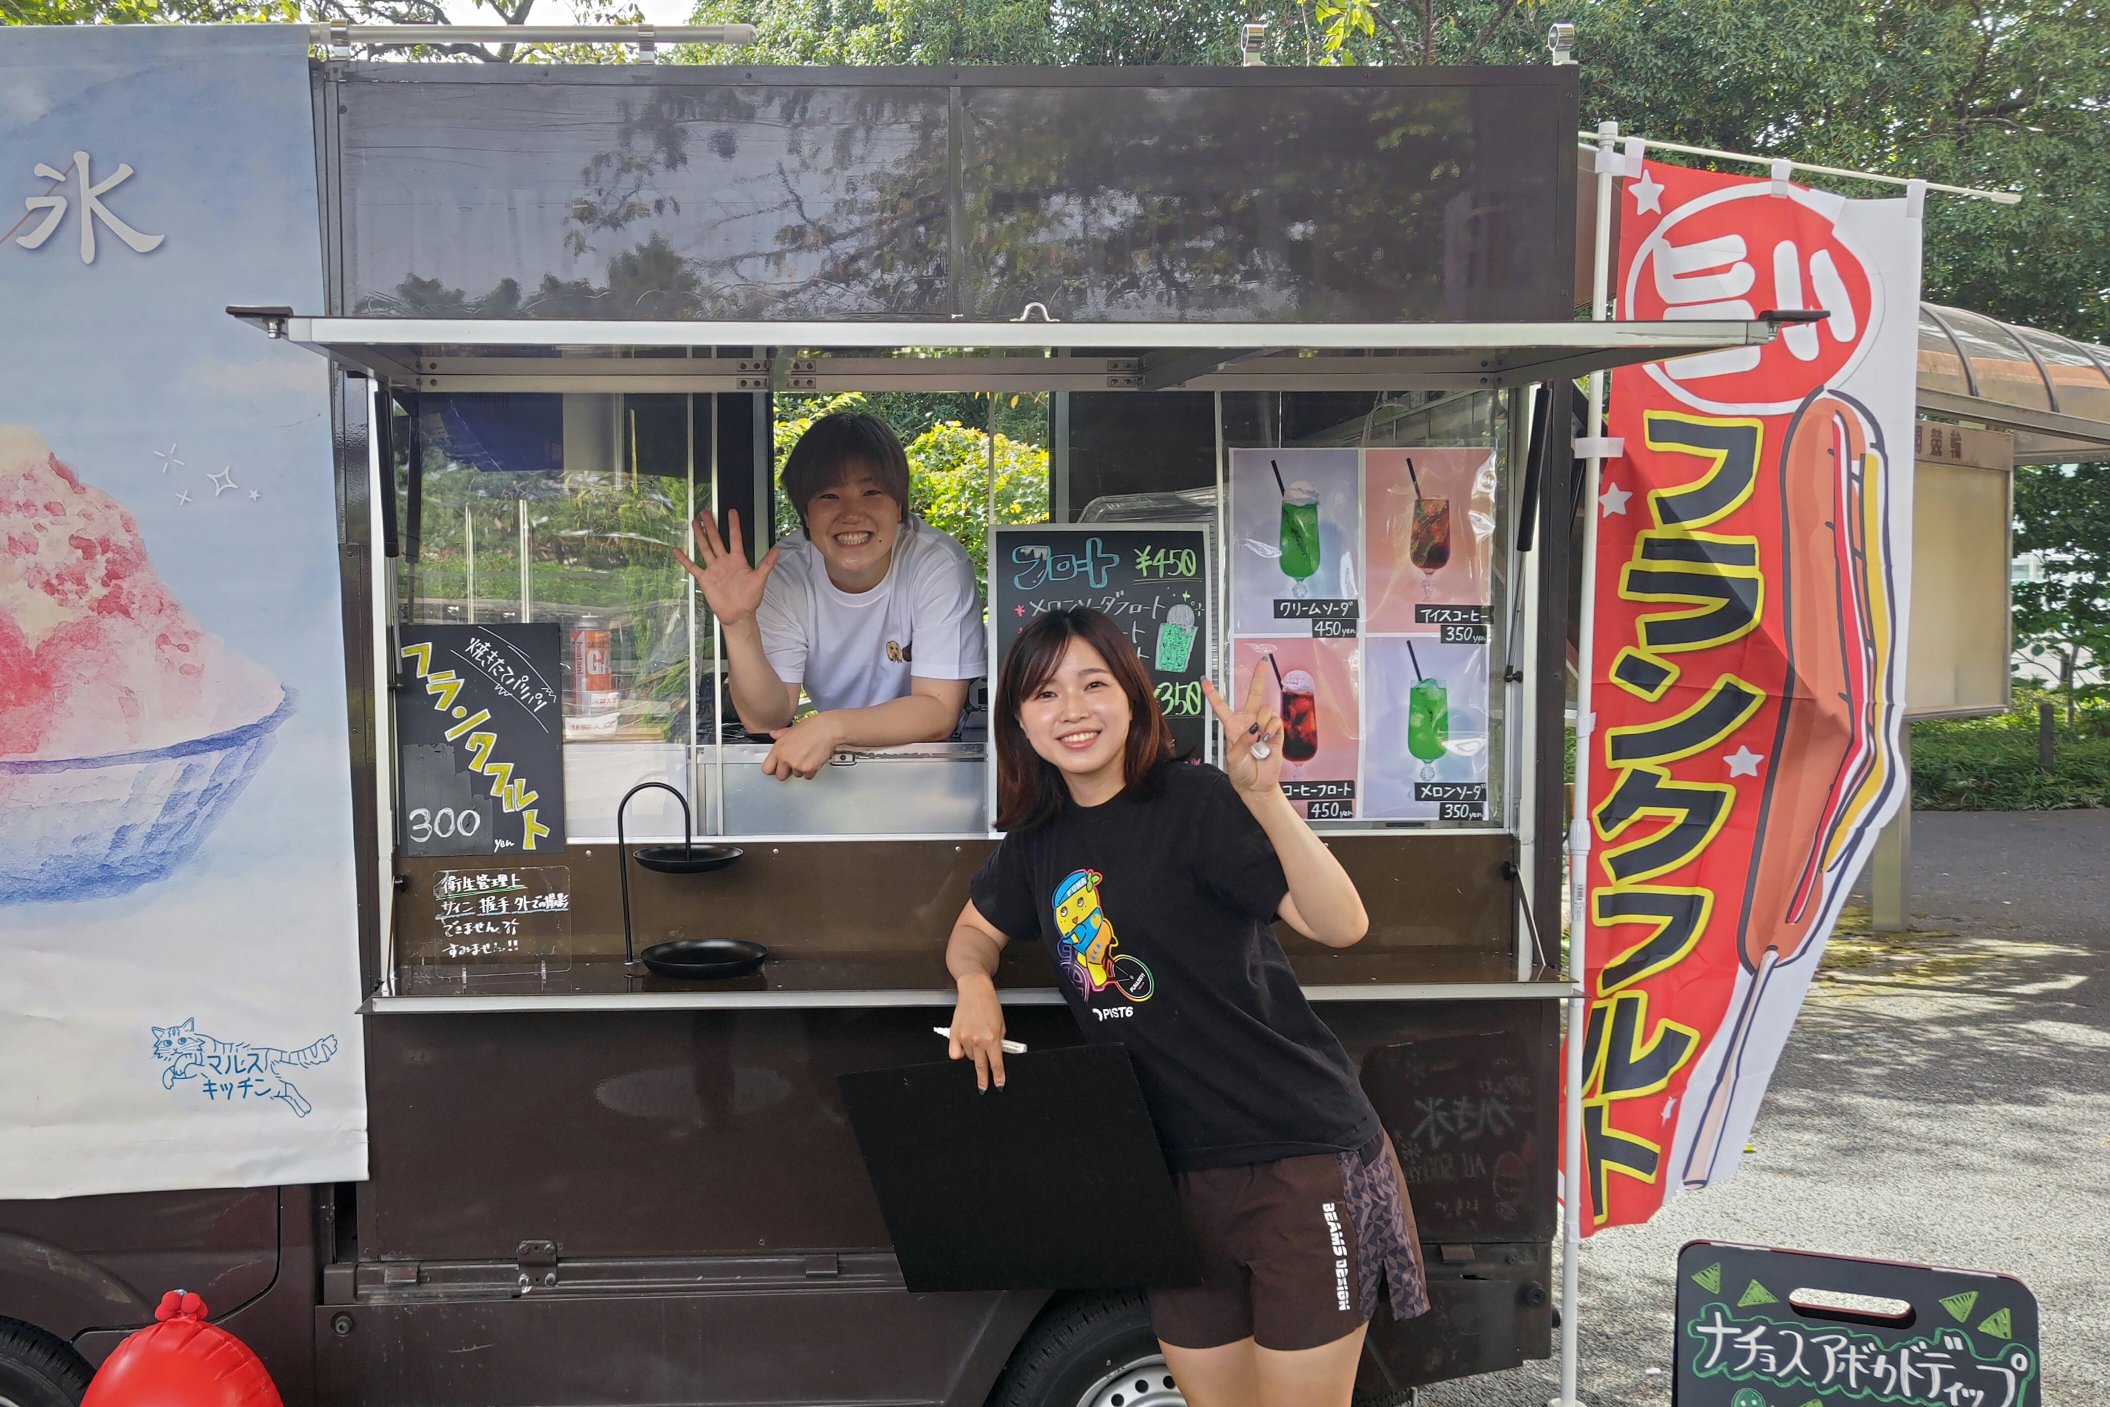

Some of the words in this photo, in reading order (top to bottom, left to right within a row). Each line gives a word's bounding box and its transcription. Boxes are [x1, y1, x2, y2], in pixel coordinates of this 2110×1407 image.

[15, 150, 166, 265] 氷
[1011, 536, 1120, 590] フロート
[1133, 544, 1197, 579] ¥450
[1279, 601, 1354, 617] クリームソーダ
[1420, 608, 1489, 623] アイスコーヒー
[1314, 620, 1341, 636] 450
[1445, 626, 1473, 641] 350
[400, 641, 550, 851] フランクフルト
[1282, 782, 1352, 797] コーヒーフロート
[1421, 784, 1486, 800] メロンソーダ
[1311, 802, 1340, 818] 450
[1444, 804, 1470, 818] 350
[1565, 409, 1766, 1226] フランクフルト
[408, 806, 481, 843] 300
[494, 838, 515, 853] yen
[444, 873, 520, 893] 衛生管理上
[1102, 1006, 1134, 1020] PIST6
[207, 1053, 264, 1075] マルス
[203, 1078, 271, 1100] キッチン
[1322, 1202, 1347, 1257] BEAMS
[1696, 1311, 2028, 1407] ナチョスアボカドディップ
